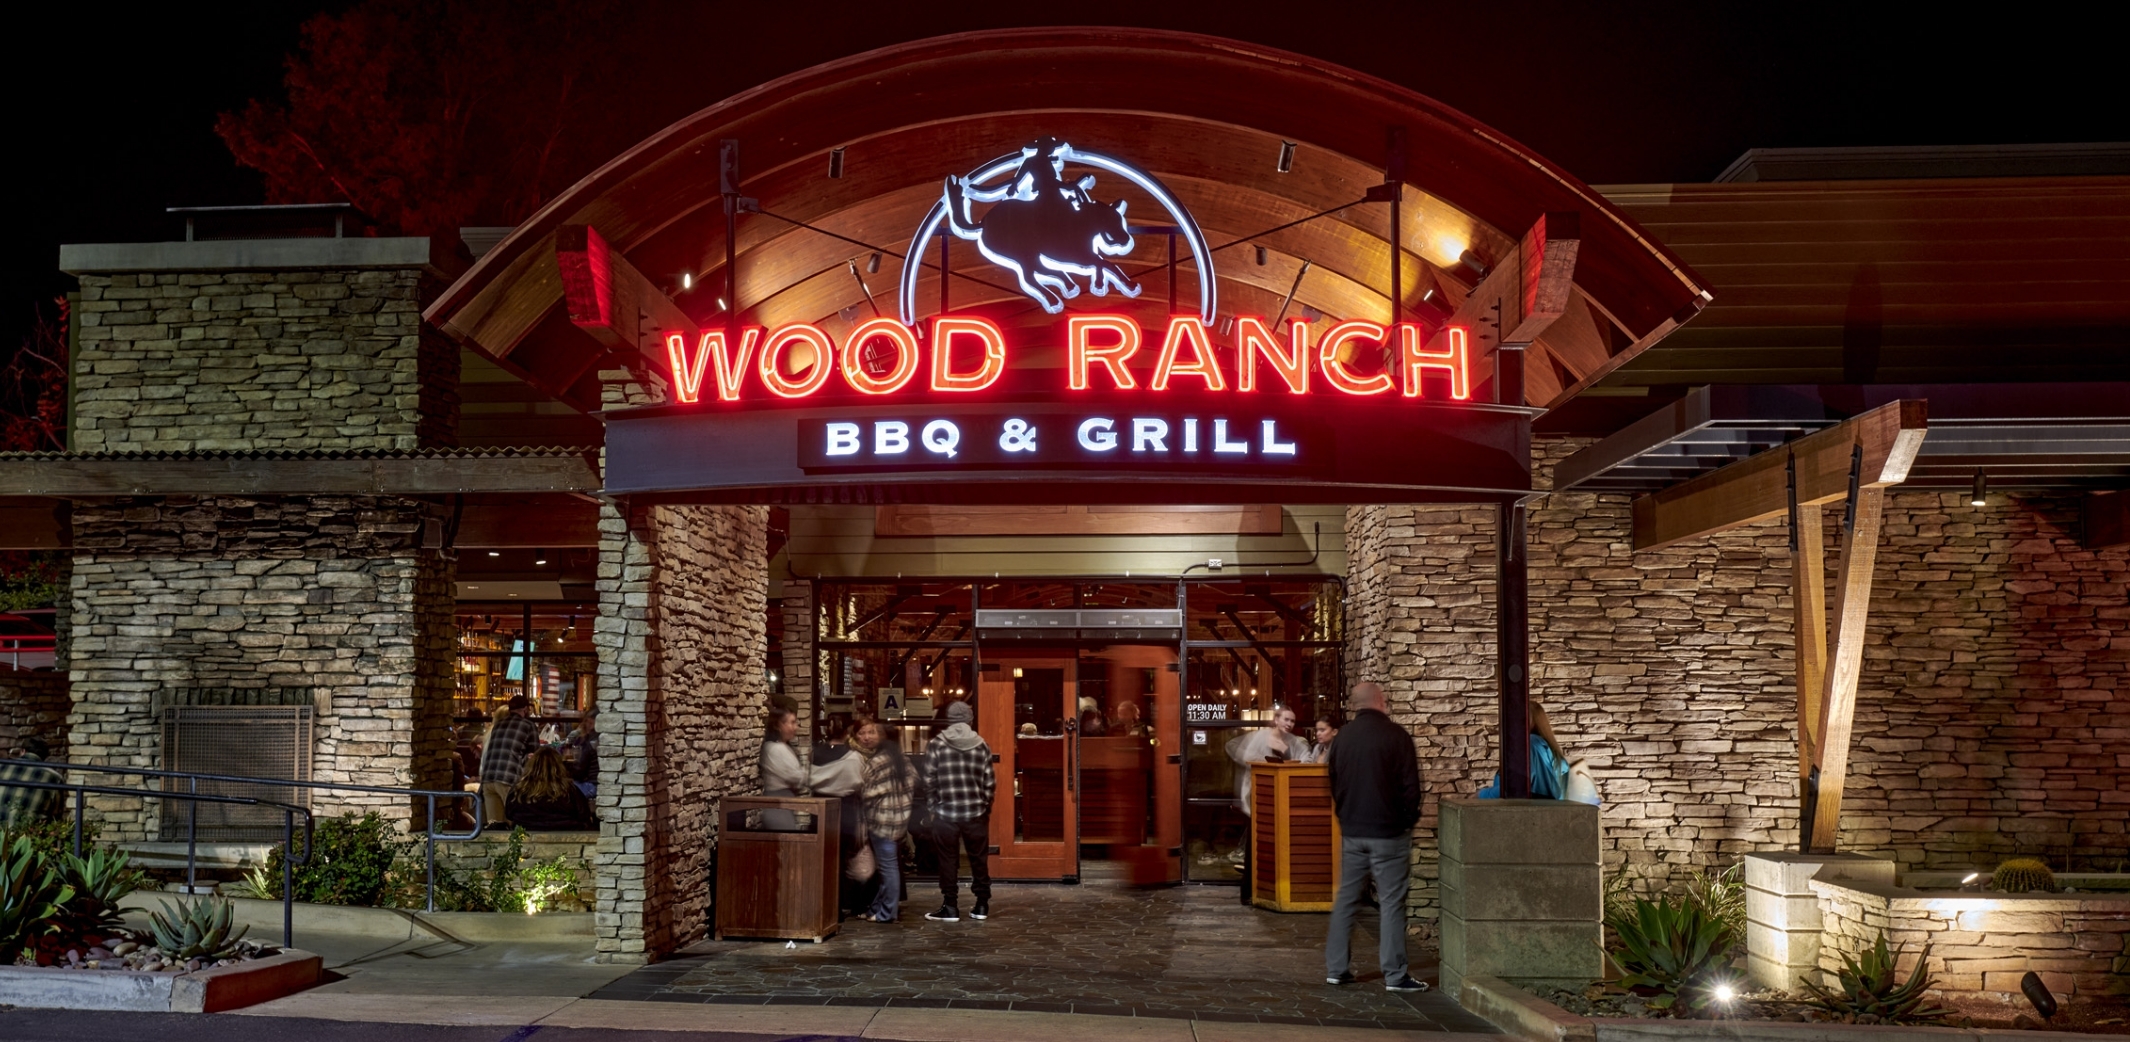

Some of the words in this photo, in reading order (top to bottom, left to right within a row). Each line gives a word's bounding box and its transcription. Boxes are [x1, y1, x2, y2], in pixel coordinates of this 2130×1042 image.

[665, 315, 1007, 404] WOOD
[1067, 313, 1472, 401] RANCH
[825, 419, 960, 458] BBQ
[999, 418, 1037, 453] &
[1077, 417, 1297, 455] GRILL
[884, 695, 899, 709] A
[1188, 711, 1210, 719] 11:30
[1212, 711, 1226, 719] AM
